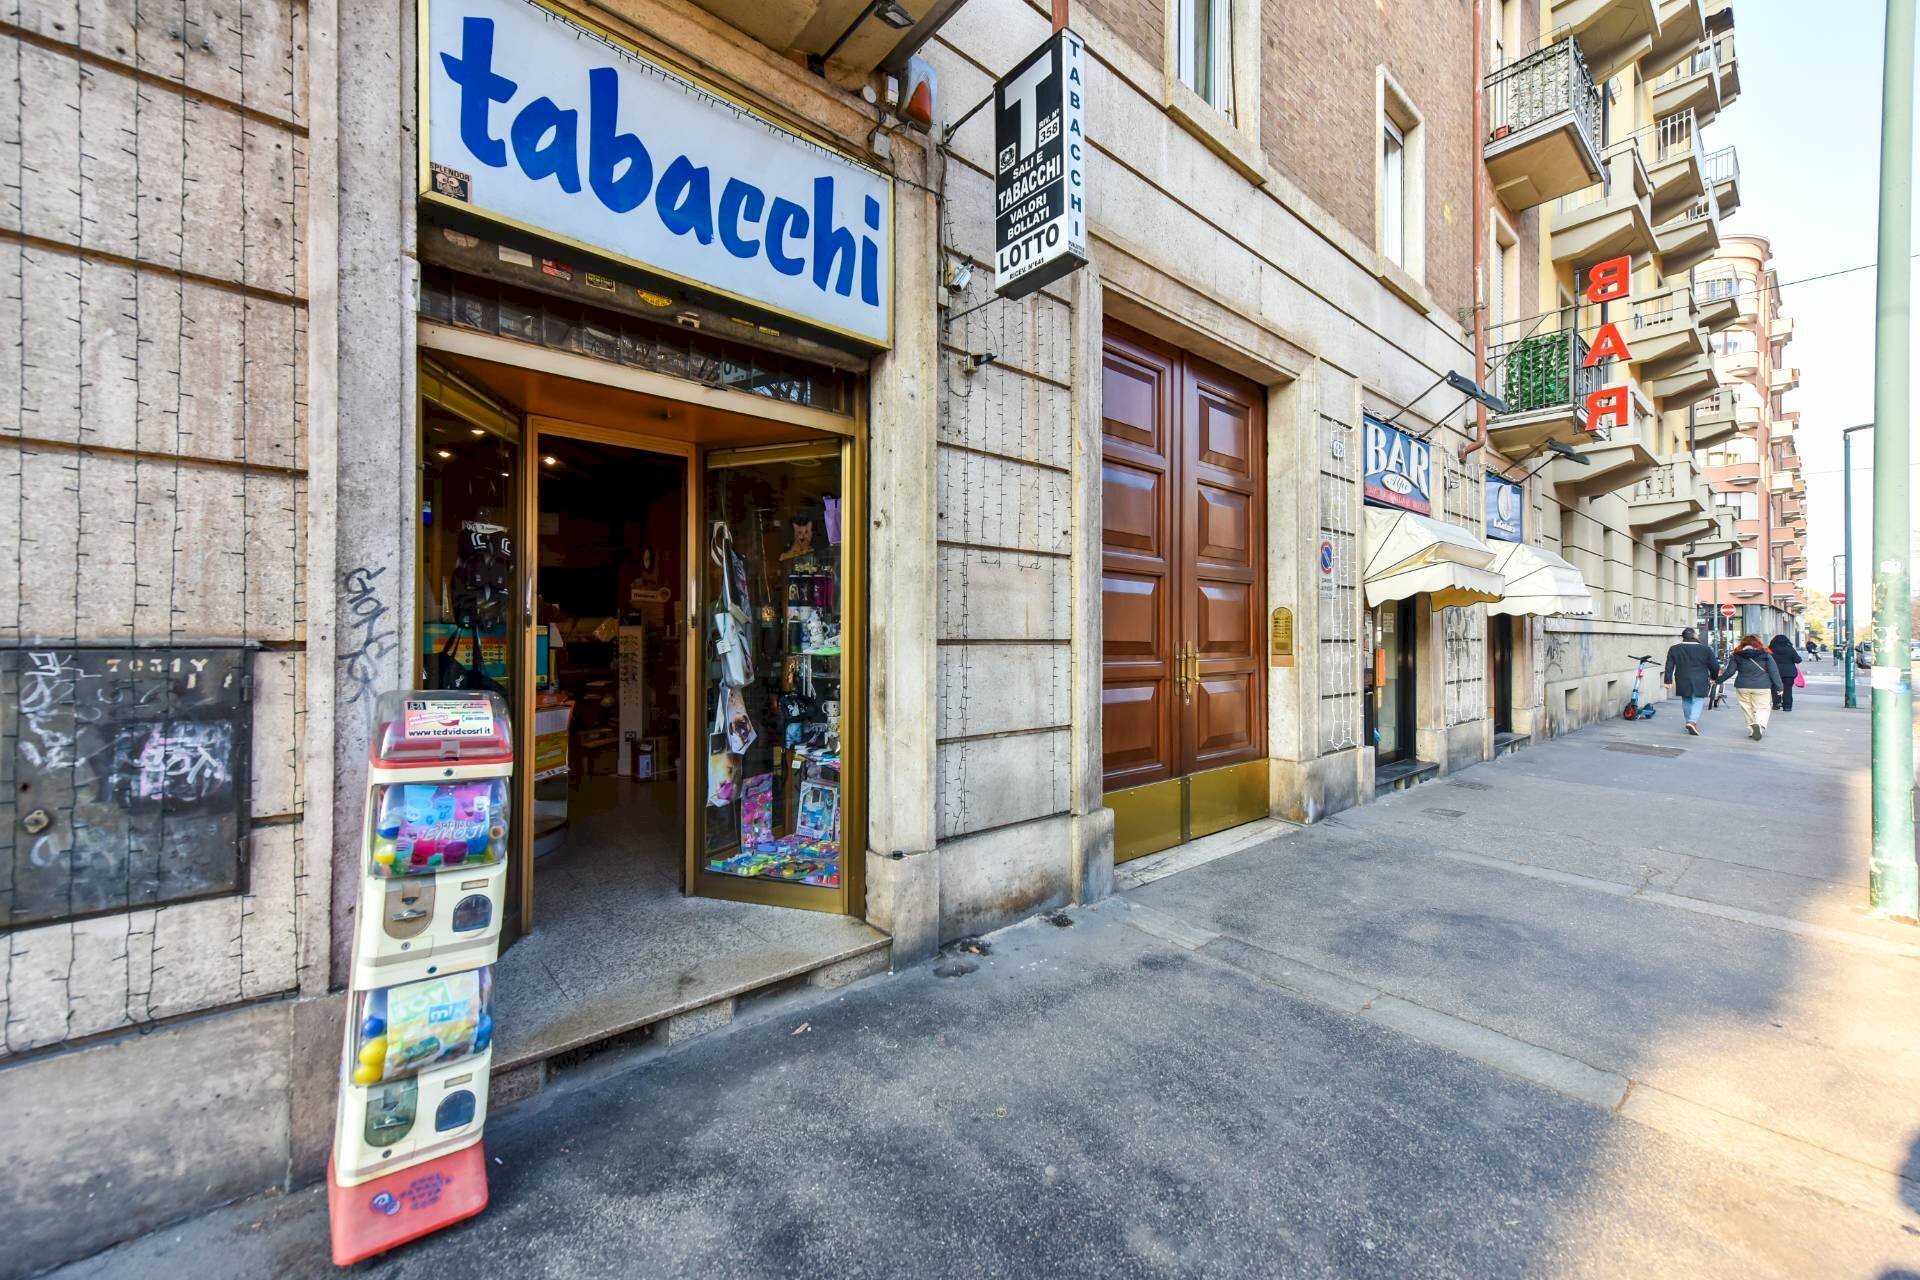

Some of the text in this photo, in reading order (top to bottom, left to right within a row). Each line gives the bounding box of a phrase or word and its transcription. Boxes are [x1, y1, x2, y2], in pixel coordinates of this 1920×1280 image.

[1004, 49, 1053, 161] T
[1040, 121, 1058, 143] 358
[1069, 38, 1082, 237] TABACCHI
[429, 161, 471, 182] SPLENDOR
[440, 16, 880, 306] tabacchi
[998, 153, 1061, 212] TABACCHI
[1012, 150, 1044, 180] SALI E
[1007, 206, 1050, 240] BOLLATI
[1009, 193, 1047, 224] VALORI
[999, 223, 1060, 274] LOTTO
[1364, 421, 1430, 501] BAR
